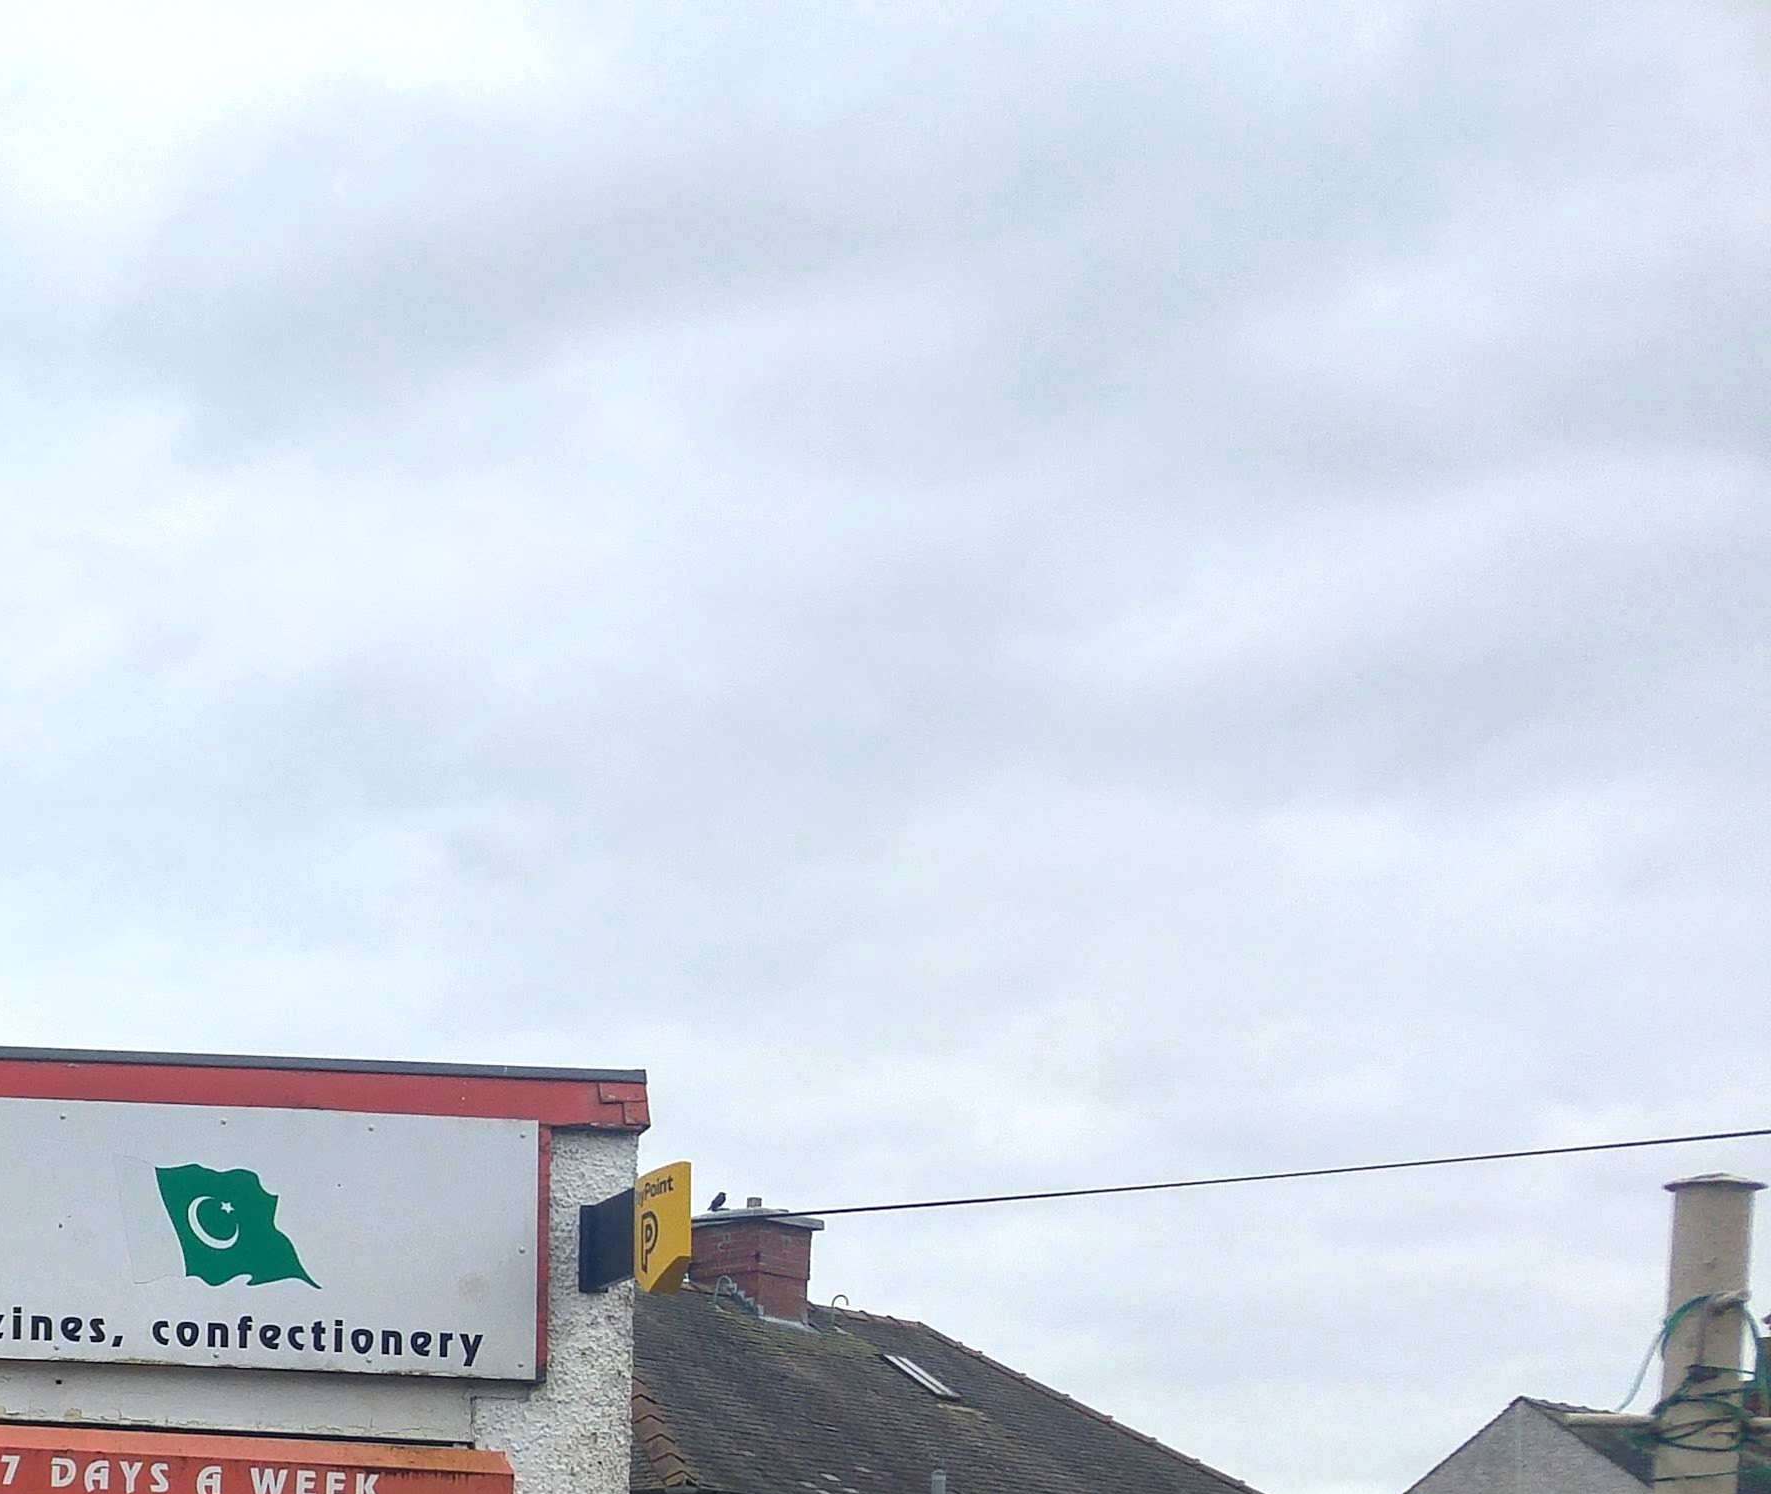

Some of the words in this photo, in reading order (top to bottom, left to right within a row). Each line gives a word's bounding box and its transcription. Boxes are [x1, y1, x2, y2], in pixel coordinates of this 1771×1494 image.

[151, 1315, 485, 1368] confectionery
[0, 1454, 22, 1487] 7
[50, 1457, 171, 1494] DAYS
